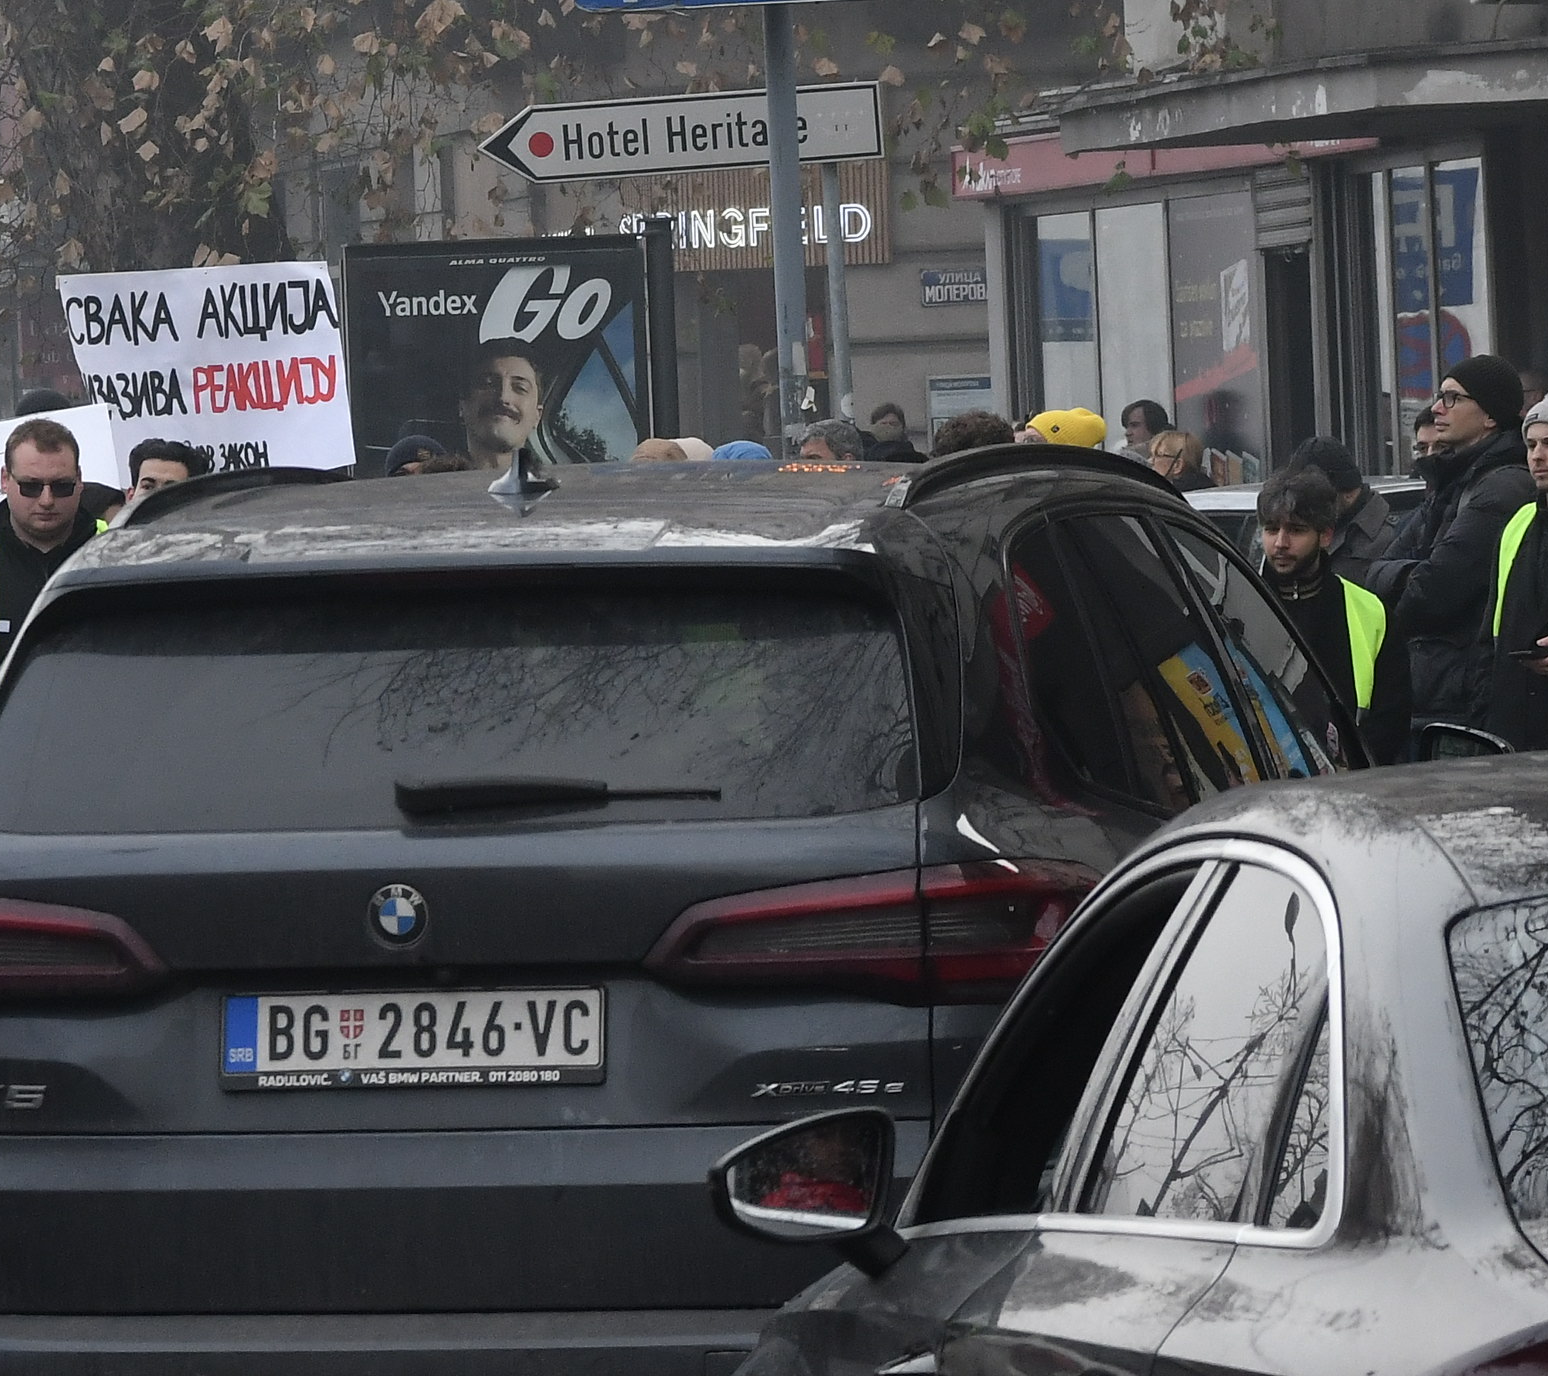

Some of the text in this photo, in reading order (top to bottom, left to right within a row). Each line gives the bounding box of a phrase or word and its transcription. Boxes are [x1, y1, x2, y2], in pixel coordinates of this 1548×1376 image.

[562, 108, 809, 162] Hotel Heritae
[448, 256, 547, 266] ALMA QUATTRO
[65, 277, 341, 347] СВАКА АКЦИЈА
[377, 264, 613, 345] Yandex Go
[925, 283, 989, 303] МОЛЕРОВ
[192, 354, 337, 415] РЕАКЦИЈУ
[229, 1048, 254, 1062] SRB
[268, 1003, 330, 1062] BG
[360, 1071, 386, 1084] VAŠ
[389, 1071, 419, 1084] BMW
